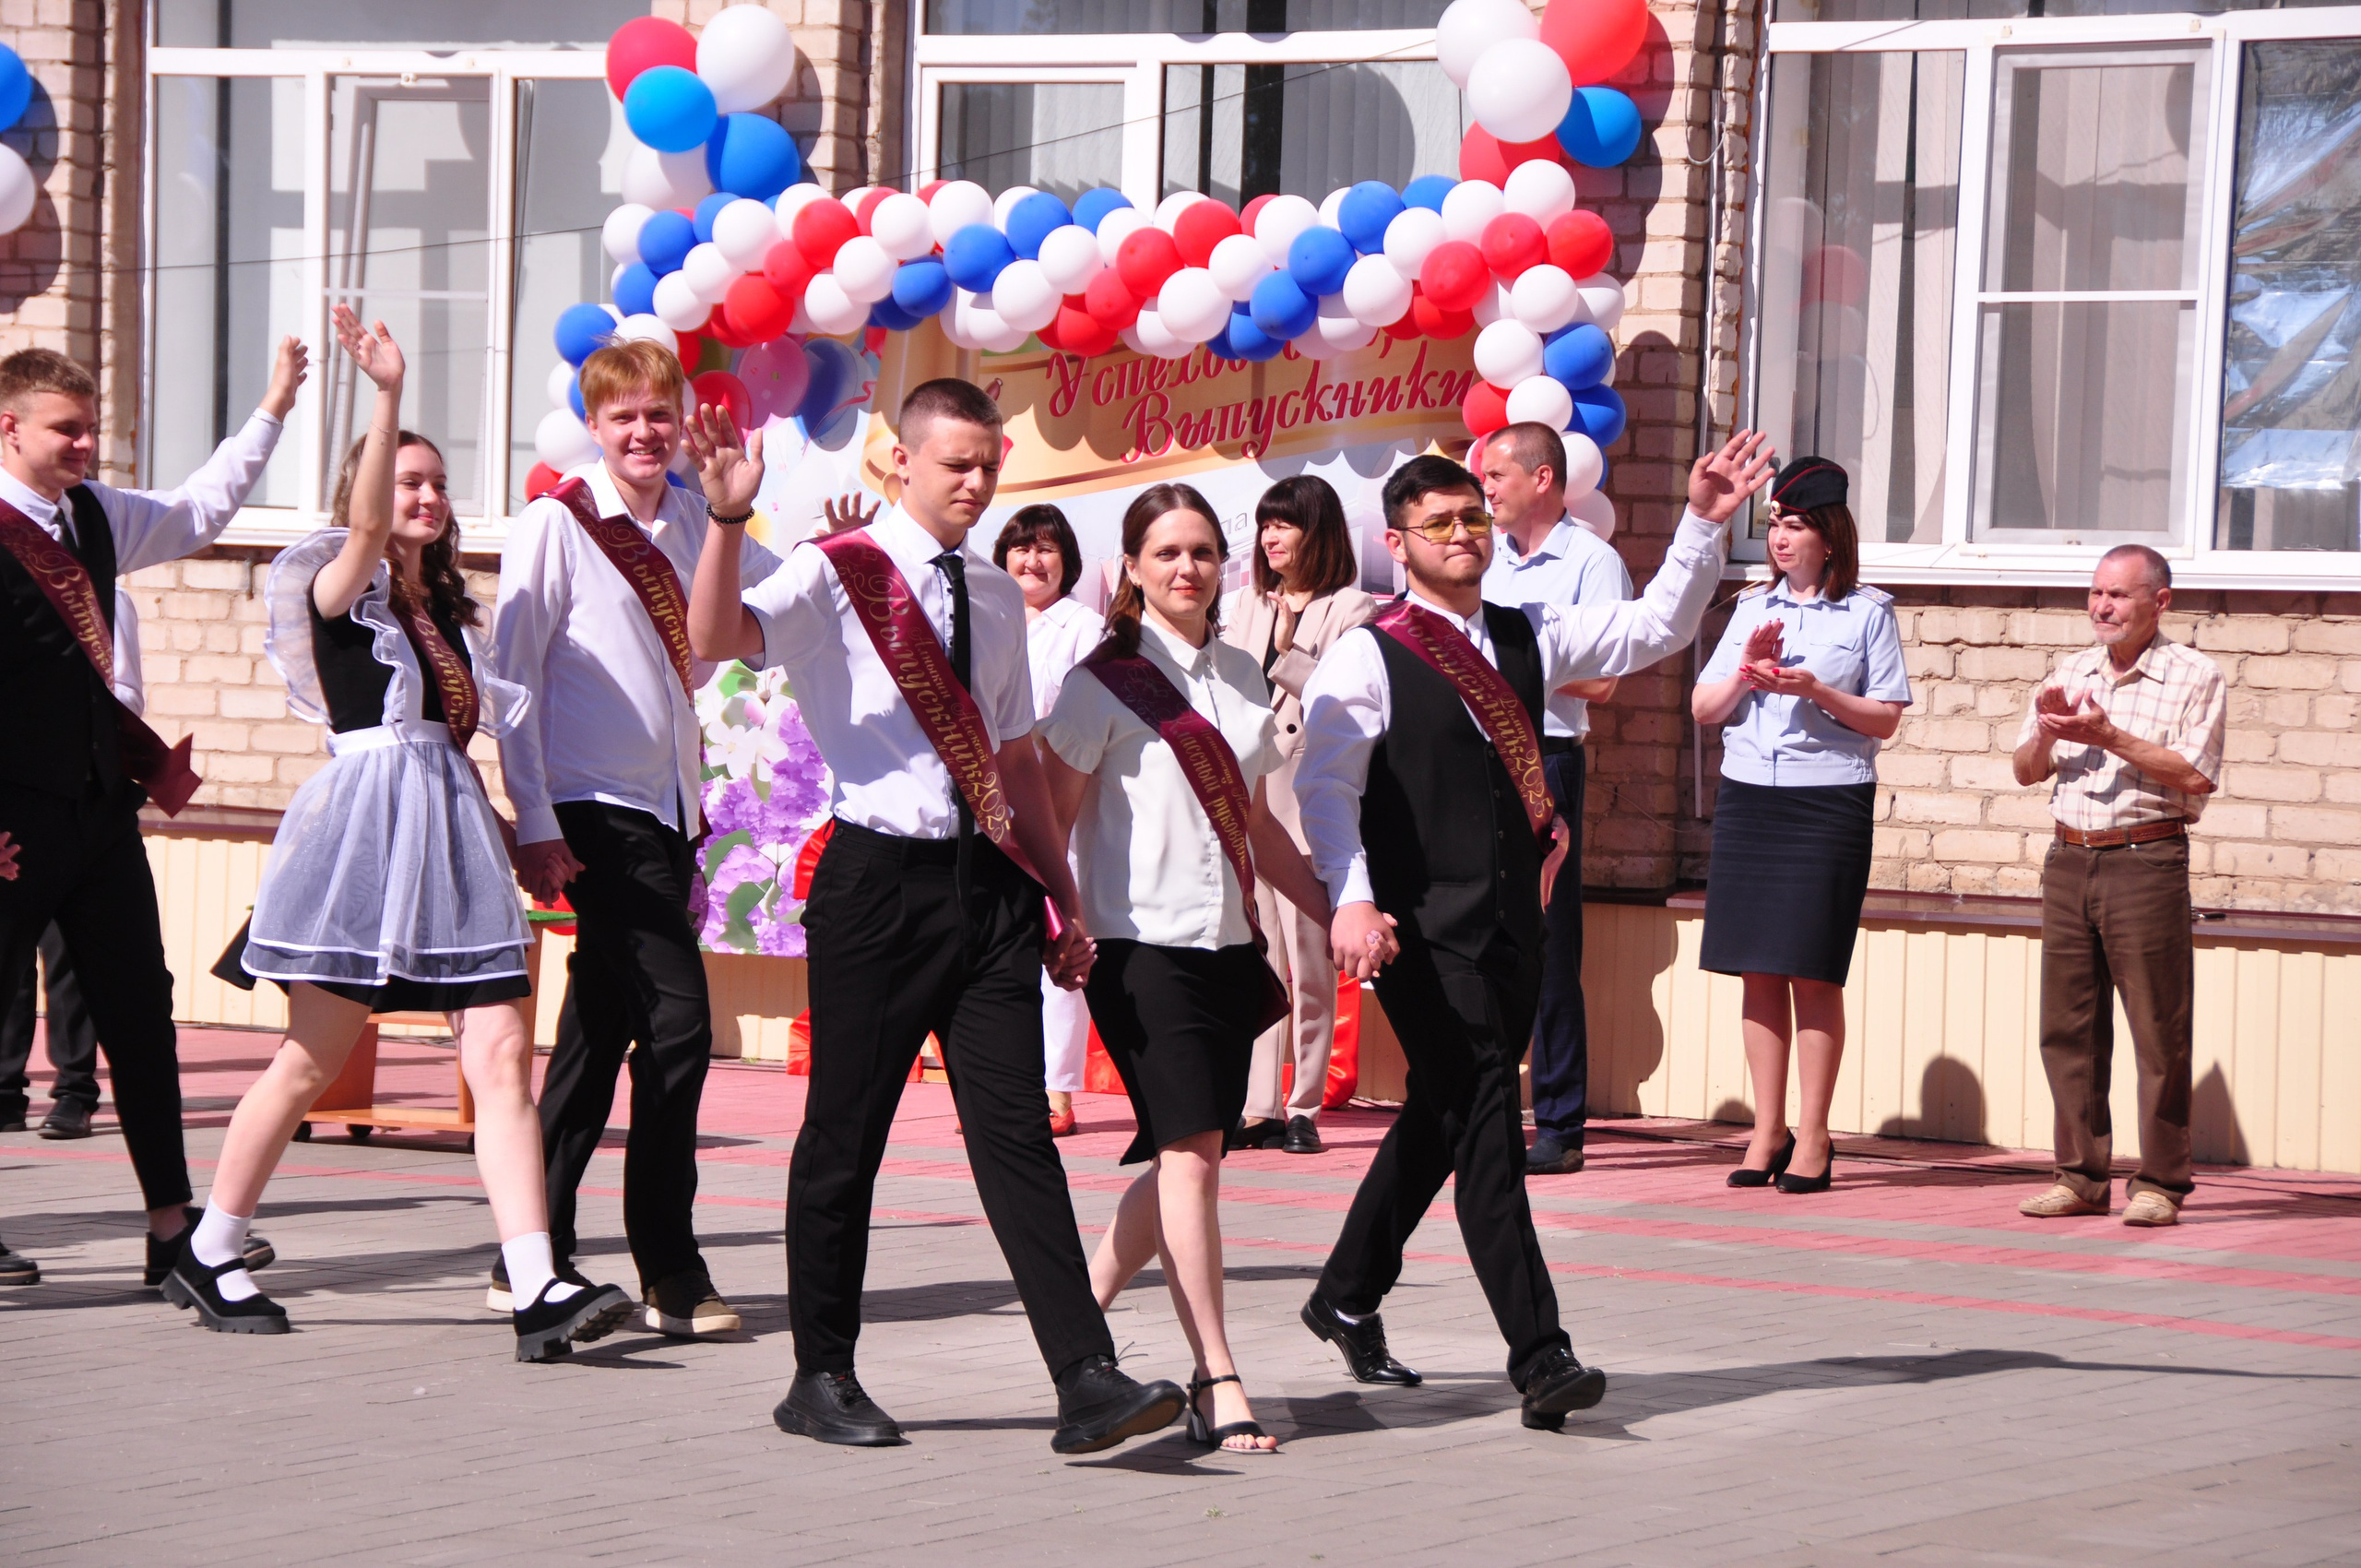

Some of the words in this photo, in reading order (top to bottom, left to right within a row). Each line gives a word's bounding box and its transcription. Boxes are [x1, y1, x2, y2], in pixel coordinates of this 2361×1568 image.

[1120, 339, 1476, 463] Выпускники
[854, 571, 982, 783] Выпускник
[972, 771, 1011, 843] 2025
[950, 702, 989, 765] Алексей
[1371, 601, 1527, 756] Выпускник
[1515, 748, 1554, 818] 2025
[1440, 622, 1497, 690] Кучеренко
[1498, 691, 1528, 742] Рамир
